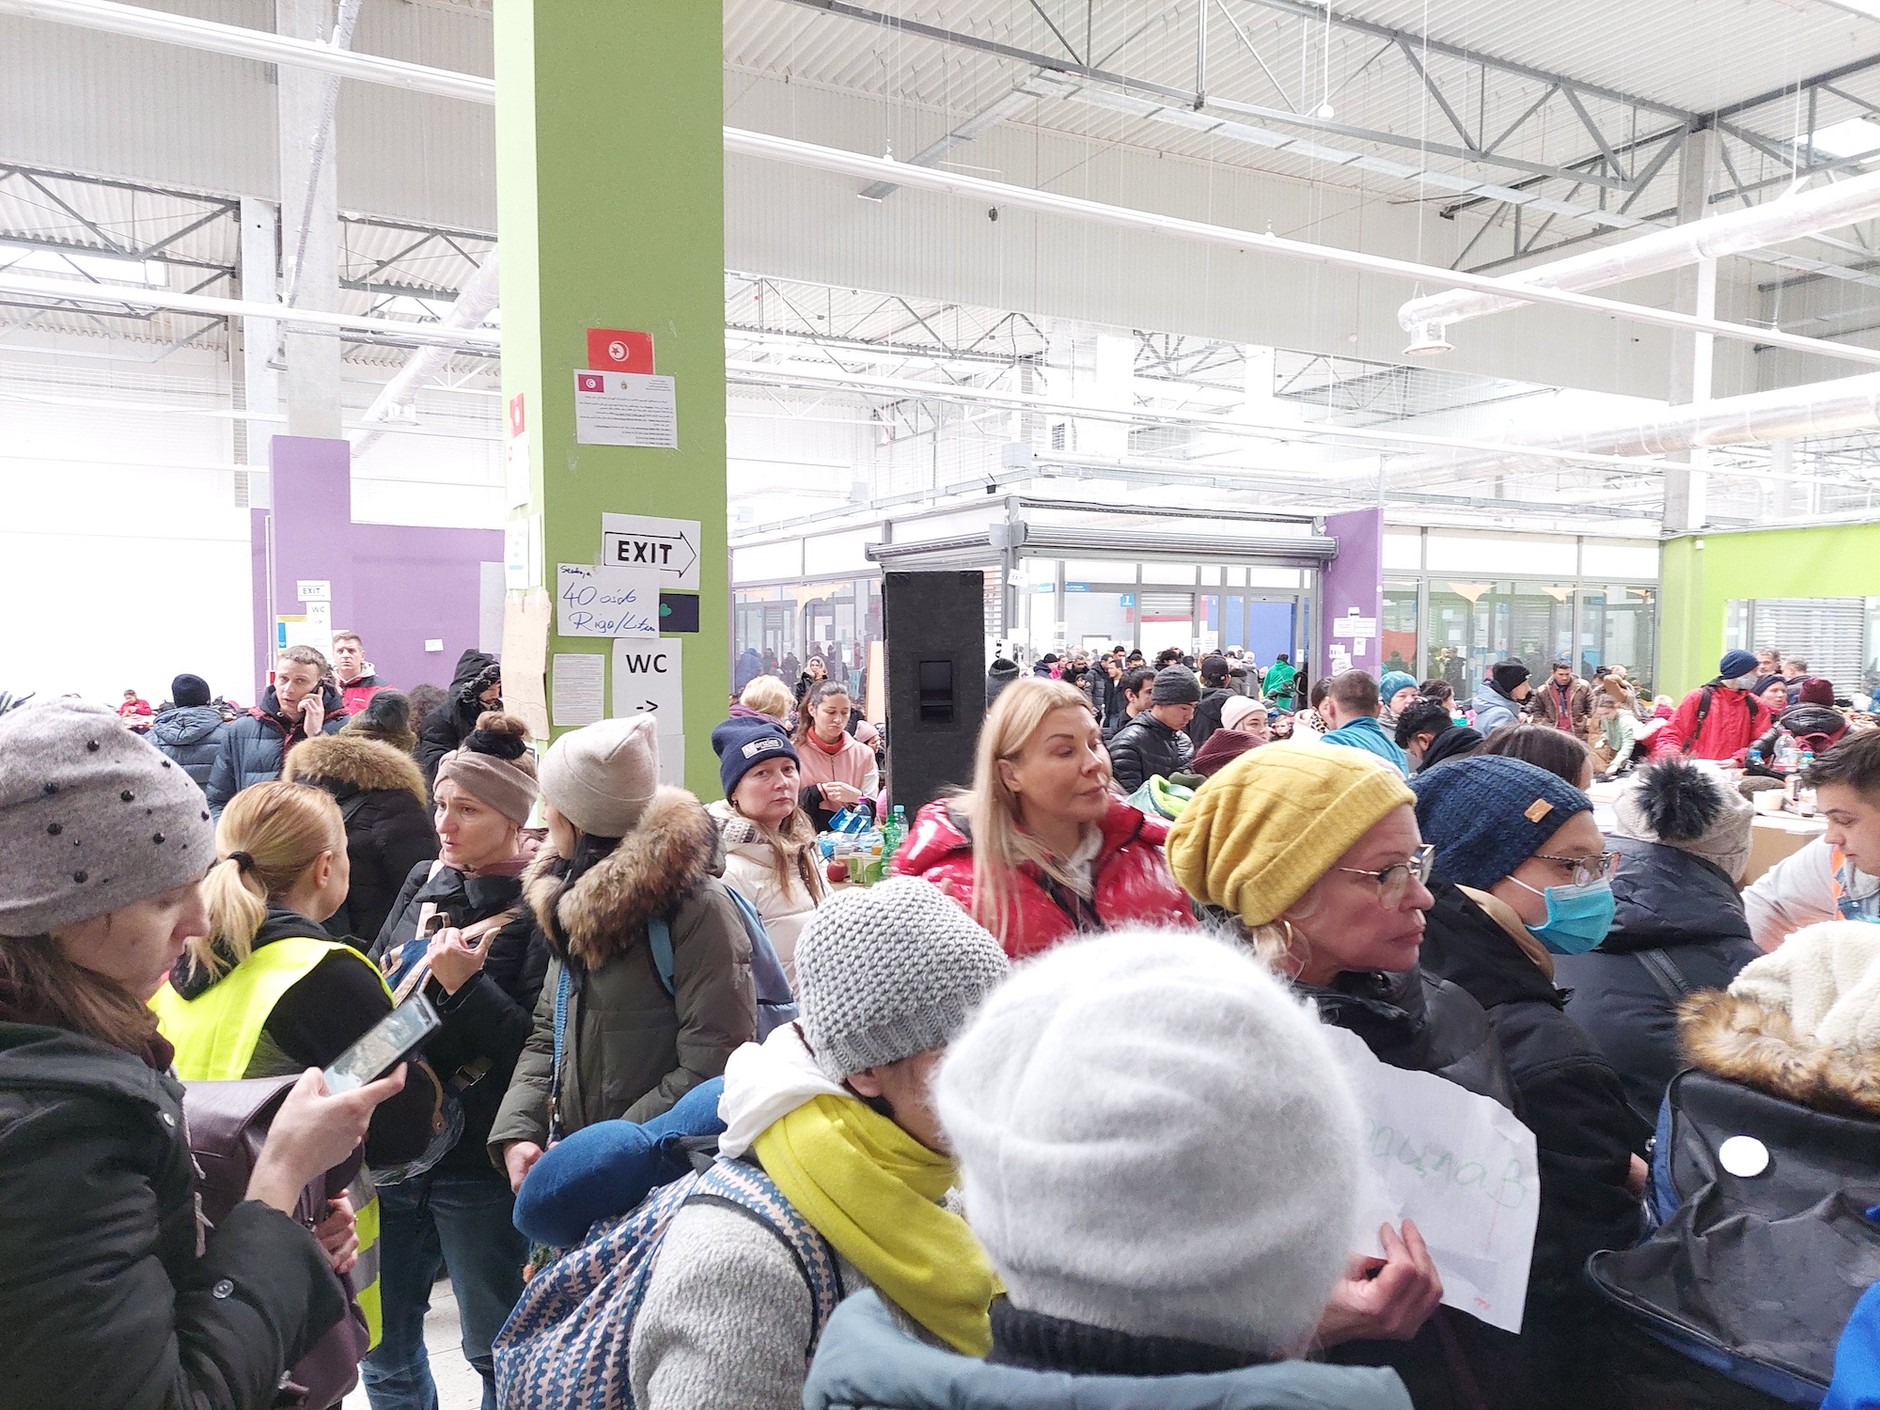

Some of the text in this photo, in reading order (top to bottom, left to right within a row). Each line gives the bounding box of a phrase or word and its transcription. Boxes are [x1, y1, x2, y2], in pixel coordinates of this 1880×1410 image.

[617, 540, 673, 565] EXIT
[302, 587, 321, 595] EXIT
[562, 582, 598, 609] 40
[625, 654, 668, 674] WC
